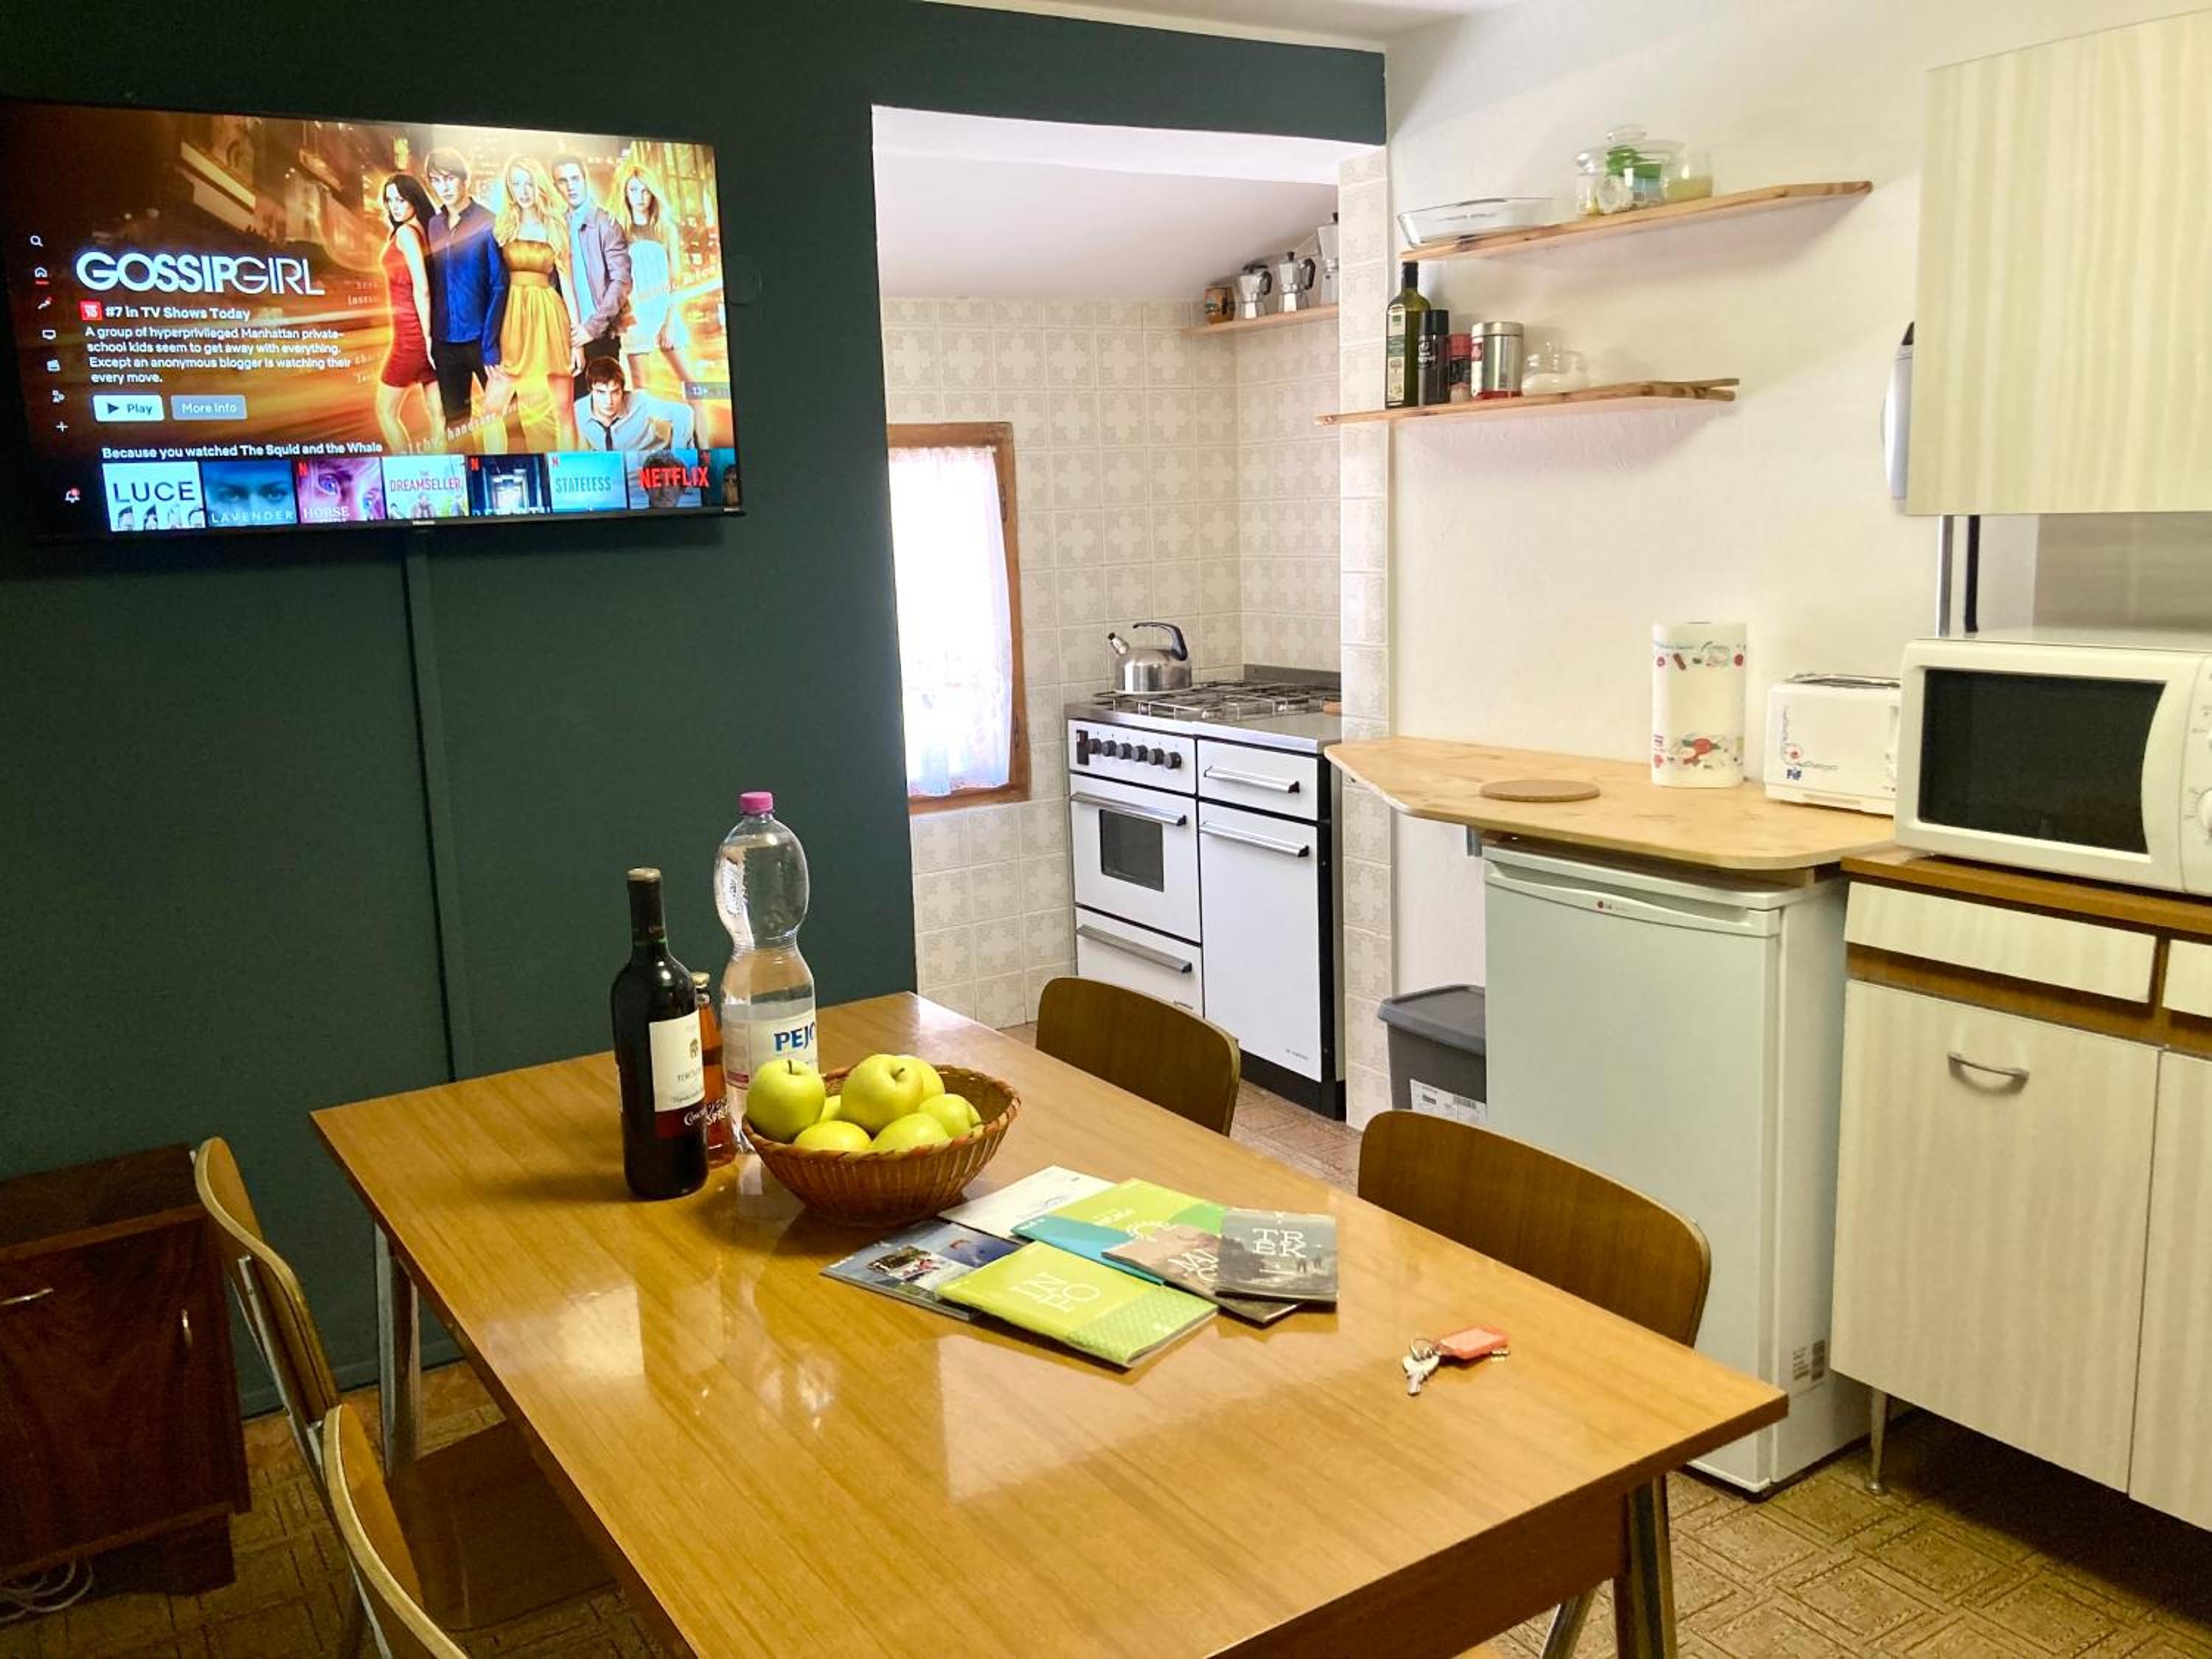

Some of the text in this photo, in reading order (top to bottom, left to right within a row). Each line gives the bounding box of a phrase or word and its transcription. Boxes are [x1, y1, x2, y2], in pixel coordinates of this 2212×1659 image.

[105, 307, 250, 321] #7 in TV Shows Today
[85, 327, 344, 340] A group of hyperprivileged Manhattan private-
[87, 342, 341, 355] school kids seem to get away with everything.
[88, 357, 131, 369] Except
[133, 358, 148, 367] an
[151, 358, 218, 369] anonymous
[219, 358, 262, 369] blogger
[265, 358, 274, 367] is
[276, 358, 325, 369] watching
[327, 358, 351, 367] their
[91, 374, 163, 385] every move.
[127, 403, 153, 415] Play
[181, 403, 237, 414] More Info
[102, 442, 383, 459] Because you watched The Squid and the Whale
[639, 466, 709, 488] NETFLIX
[389, 477, 461, 492] DREAMSELLER
[555, 476, 611, 493] STATELESS
[113, 481, 195, 504] LUCE
[212, 510, 293, 523] LAVENDER
